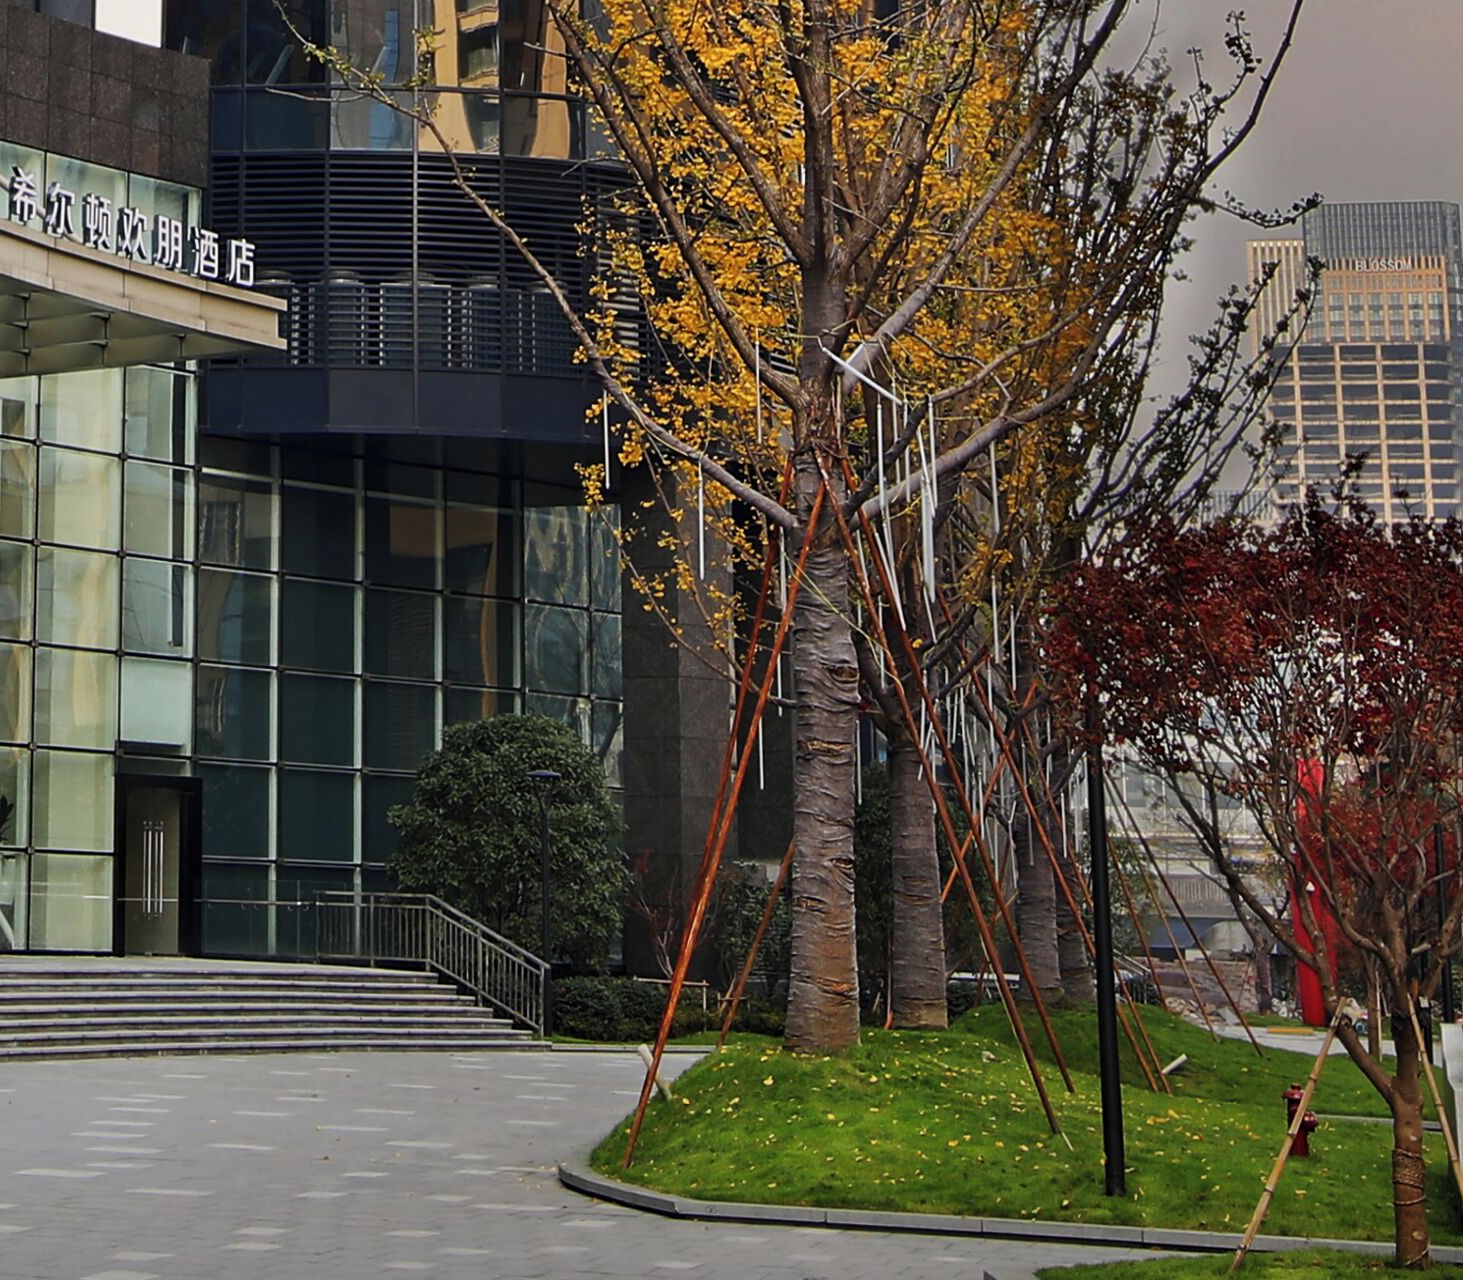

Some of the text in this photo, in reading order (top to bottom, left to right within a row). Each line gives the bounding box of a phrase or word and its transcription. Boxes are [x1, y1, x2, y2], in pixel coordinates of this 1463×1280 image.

[14, 172, 255, 286] 希尔顿欢朋酒店
[1356, 259, 1412, 272] BLOSSOM
